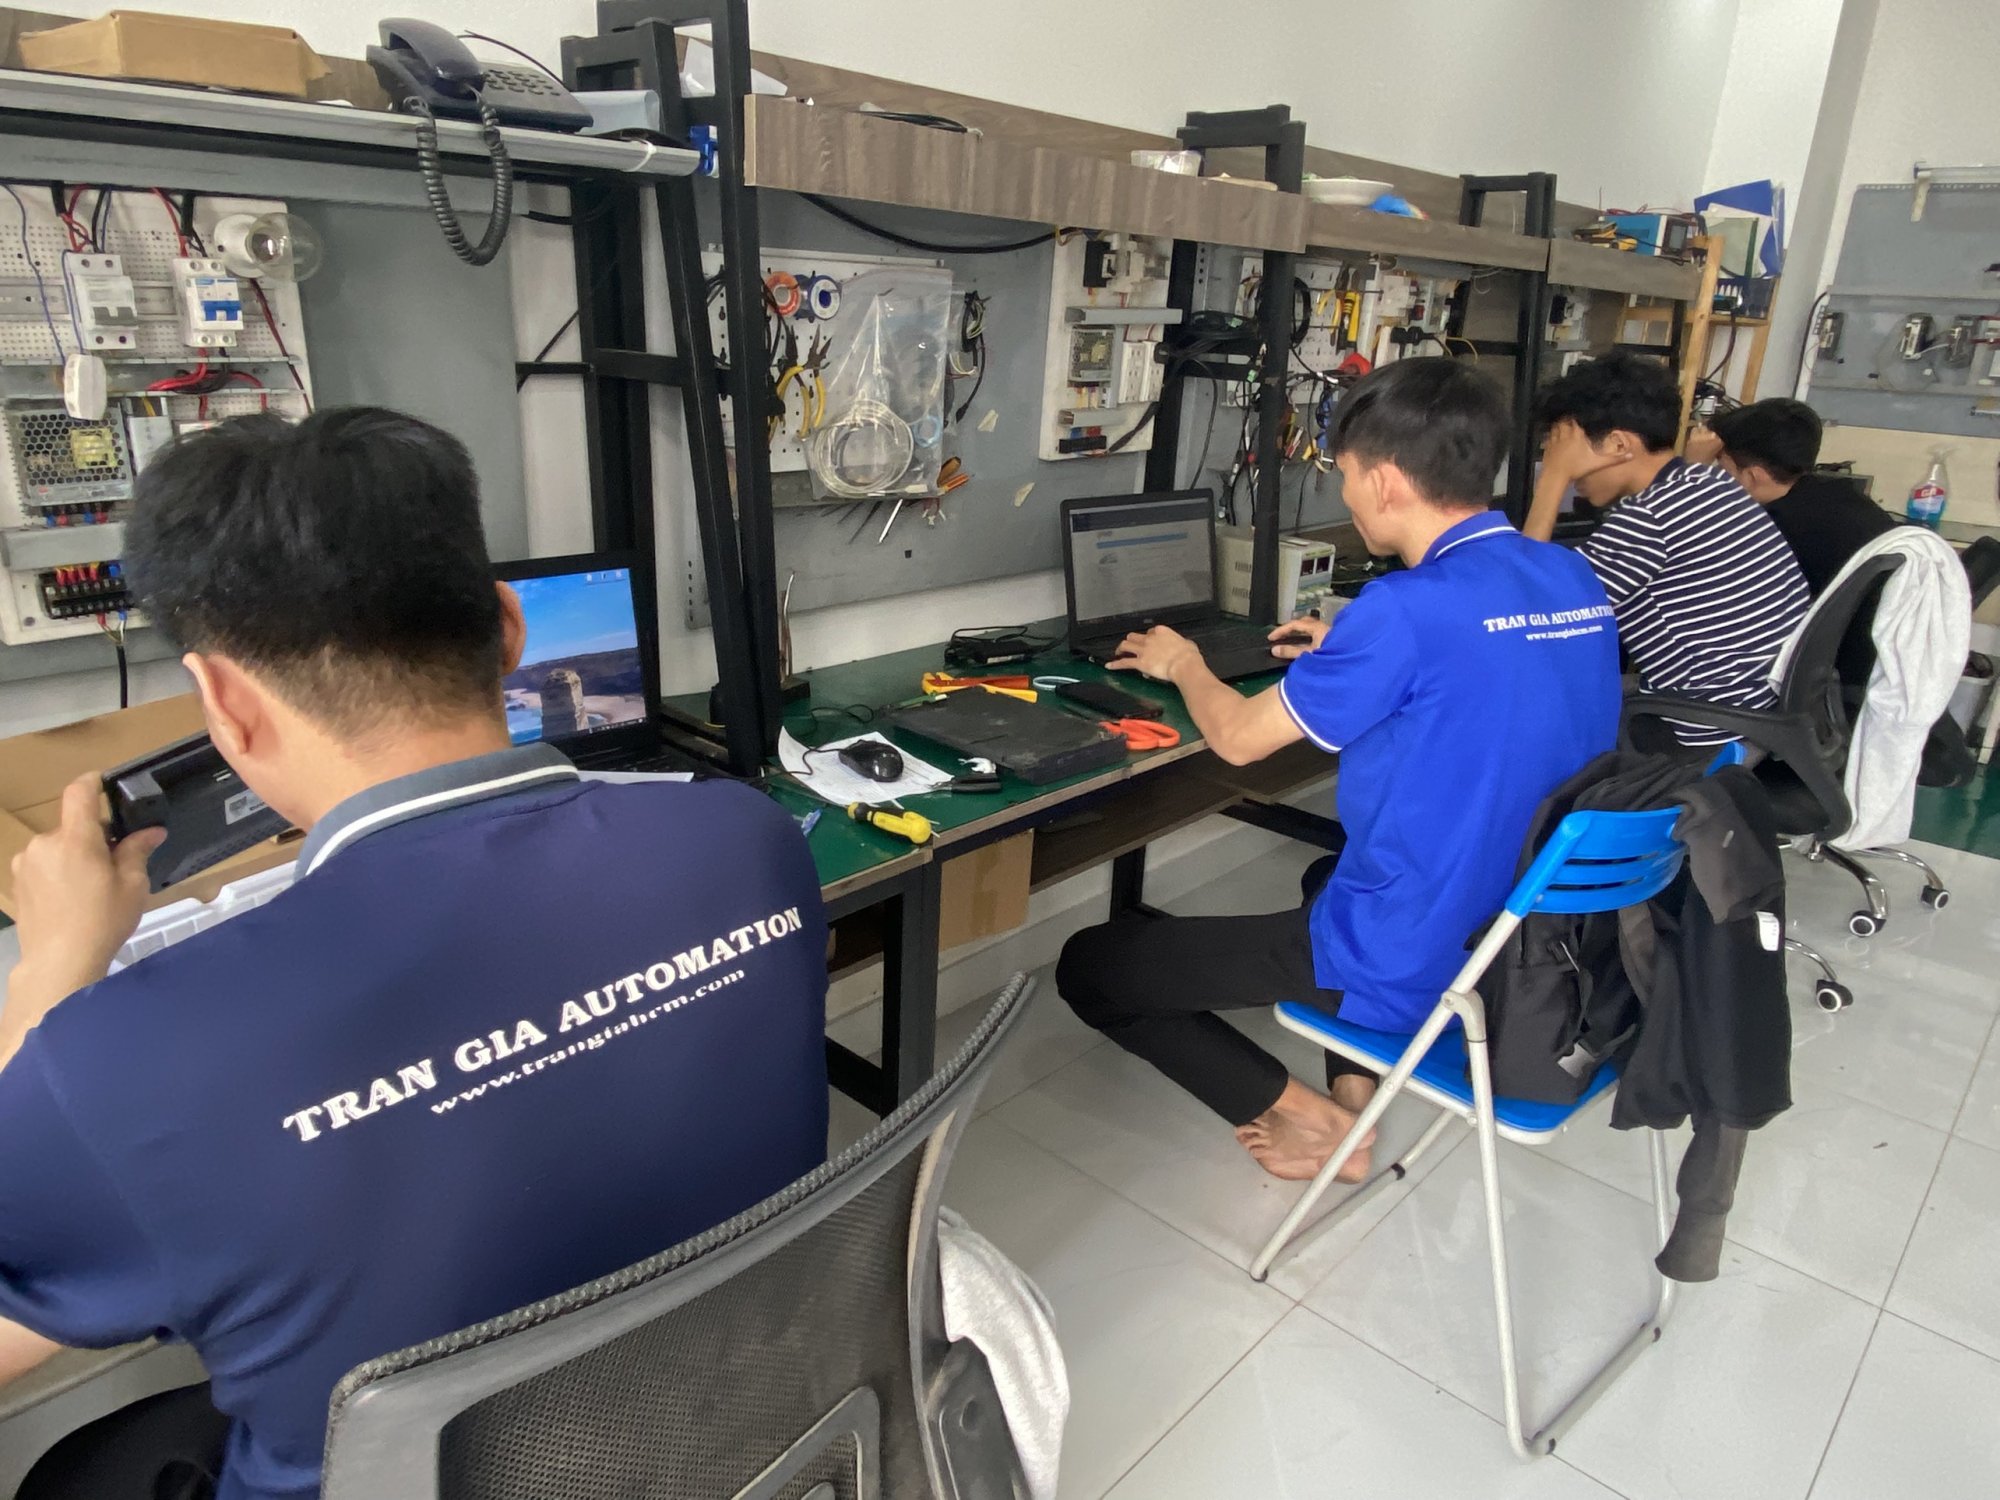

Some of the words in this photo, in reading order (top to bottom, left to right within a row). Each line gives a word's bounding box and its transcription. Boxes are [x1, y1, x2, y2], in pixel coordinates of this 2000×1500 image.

[1483, 615, 1527, 632] TRAN
[1529, 613, 1550, 626] GIA
[282, 1058, 437, 1142] TRAN
[453, 1019, 548, 1073] GIA
[558, 906, 803, 1033] AUTOMATION
[430, 969, 745, 1114] www.trangiahcm.com
